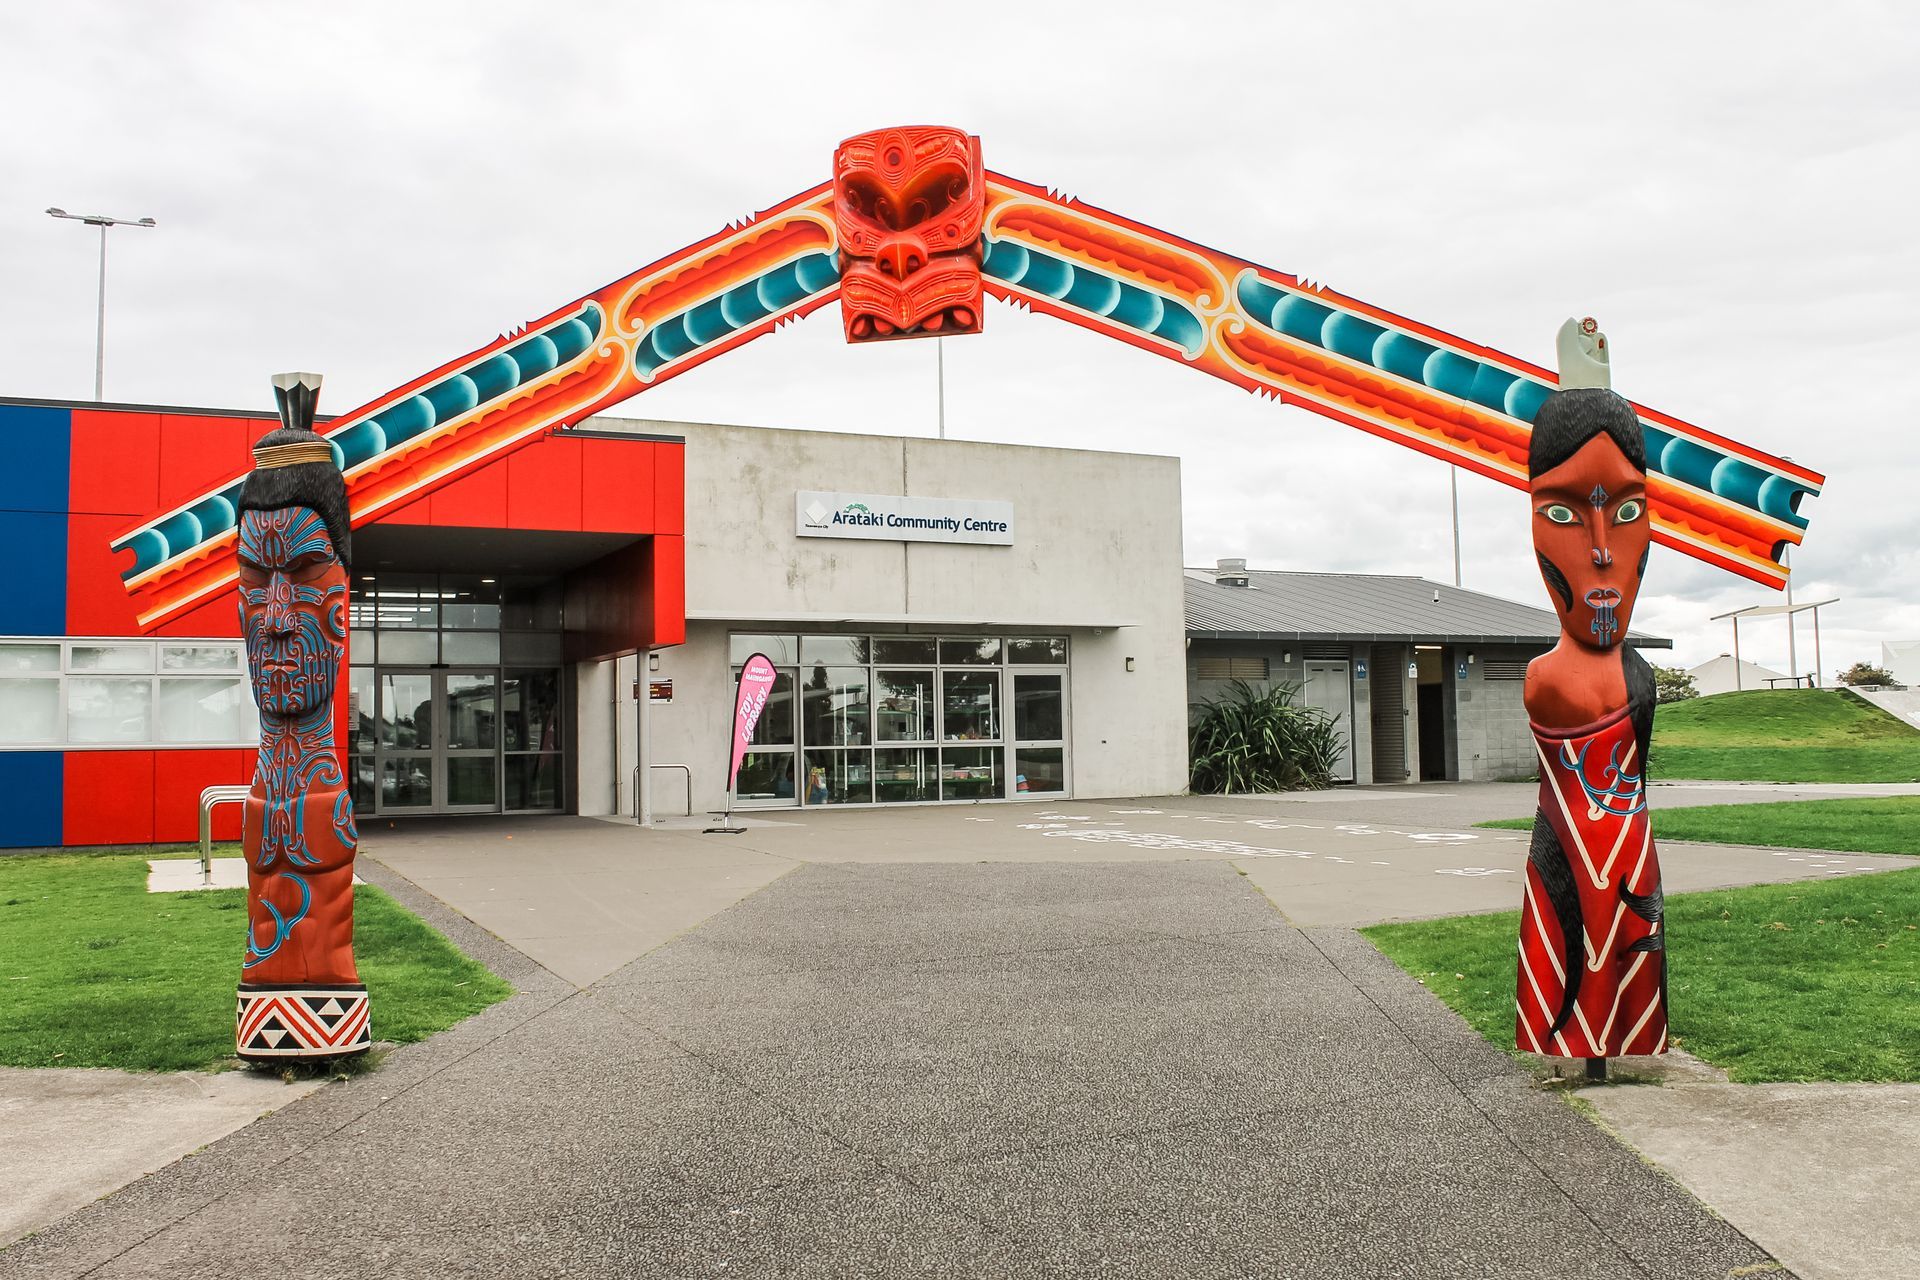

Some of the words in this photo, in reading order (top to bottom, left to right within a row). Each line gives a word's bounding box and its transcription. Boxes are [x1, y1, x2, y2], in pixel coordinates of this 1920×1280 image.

[832, 511, 884, 527] Arataki
[887, 514, 960, 533] Community
[963, 518, 1007, 532] Centre
[739, 691, 754, 720] TOY
[741, 685, 768, 743] LIBRARY
